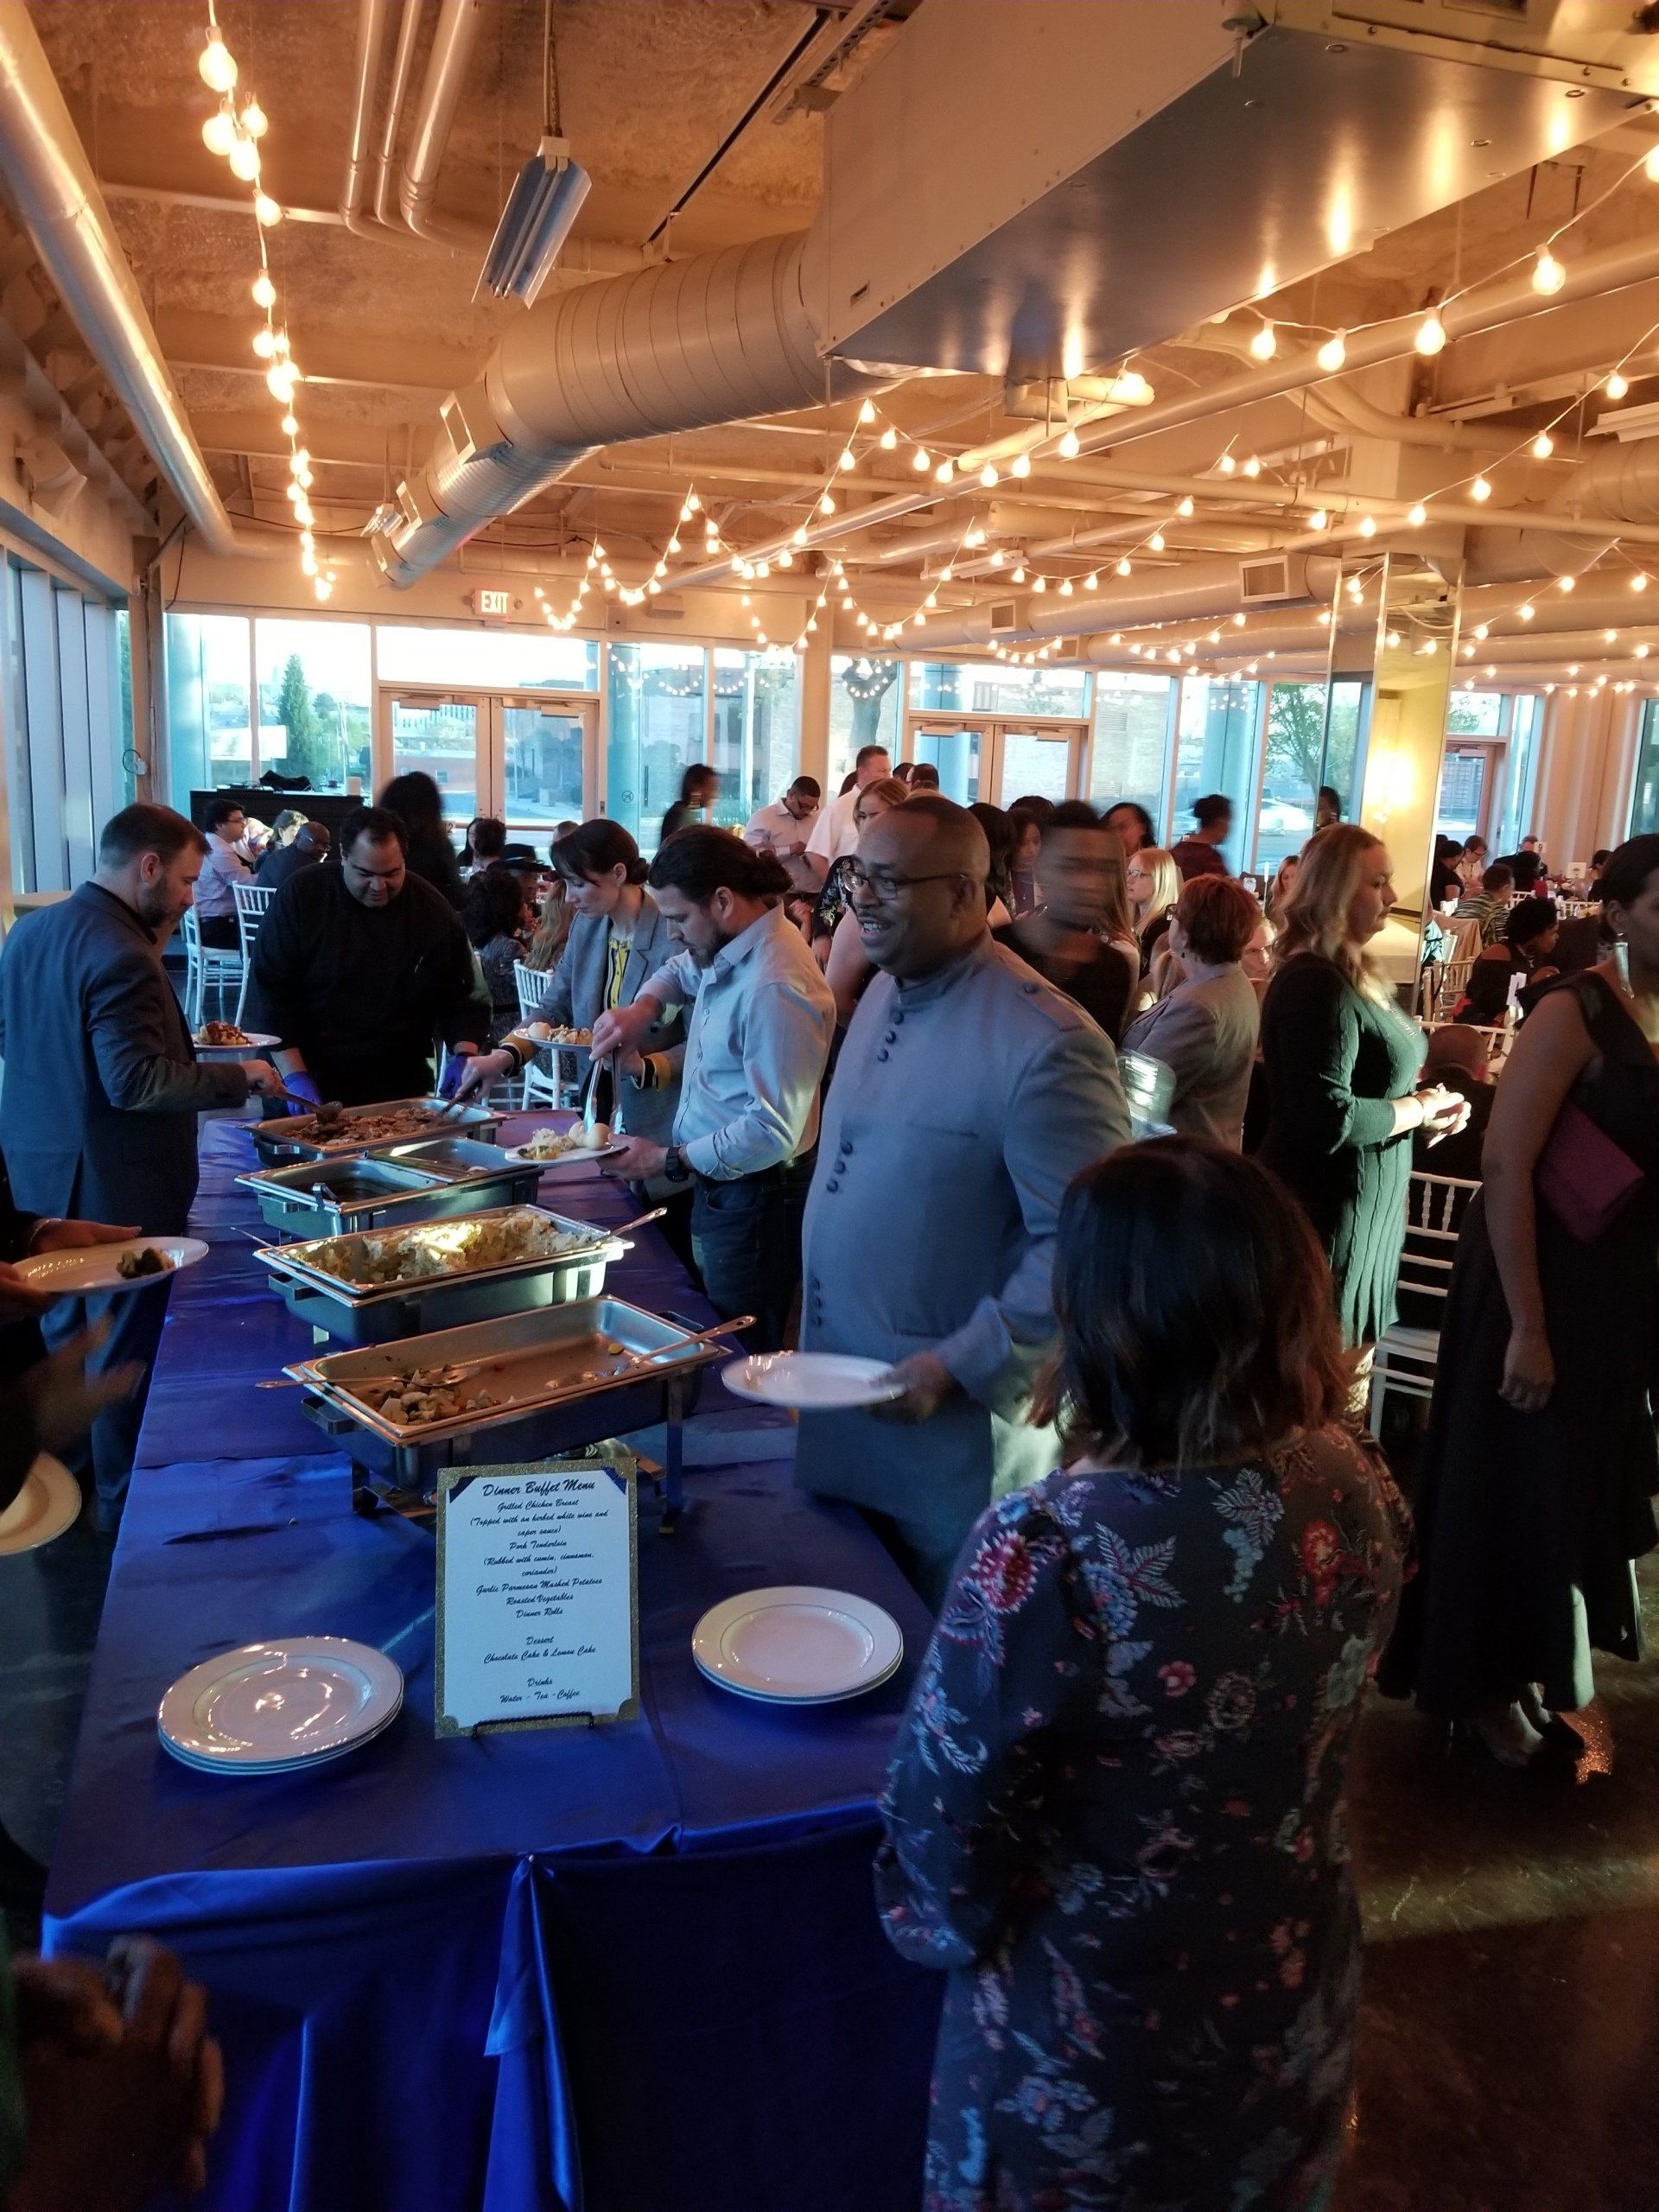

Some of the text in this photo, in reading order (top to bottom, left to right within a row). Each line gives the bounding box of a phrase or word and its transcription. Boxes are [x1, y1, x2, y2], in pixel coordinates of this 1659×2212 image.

[481, 590, 508, 613] EXIT
[483, 1478, 595, 1497] Dinner Buffet Menu
[497, 1498, 579, 1513] Grilled Chicken Breast
[470, 1516, 500, 1527] (Topped
[503, 1515, 518, 1523] with
[531, 1513, 554, 1522] herbed
[556, 1511, 575, 1520] white
[539, 1525, 562, 1535] sauce)
[509, 1540, 567, 1551] Pork Tenderloin
[483, 1556, 513, 1566] (Rubbed
[516, 1554, 531, 1563] with
[560, 1552, 594, 1560] cinnamon,
[521, 1566, 557, 1577] coriander)
[476, 1578, 602, 1596] Garlic Parmesan Mashed Potatoes
[505, 1592, 574, 1605] Roasted Vegetables
[516, 1607, 563, 1618] Dinner Rolls
[525, 1636, 555, 1645] Dessert
[484, 1644, 596, 1664] Chocolate Cake & Lemon Cake
[526, 1676, 553, 1687] Drinks
[499, 1694, 523, 1703] Water
[534, 1691, 548, 1700] Tea
